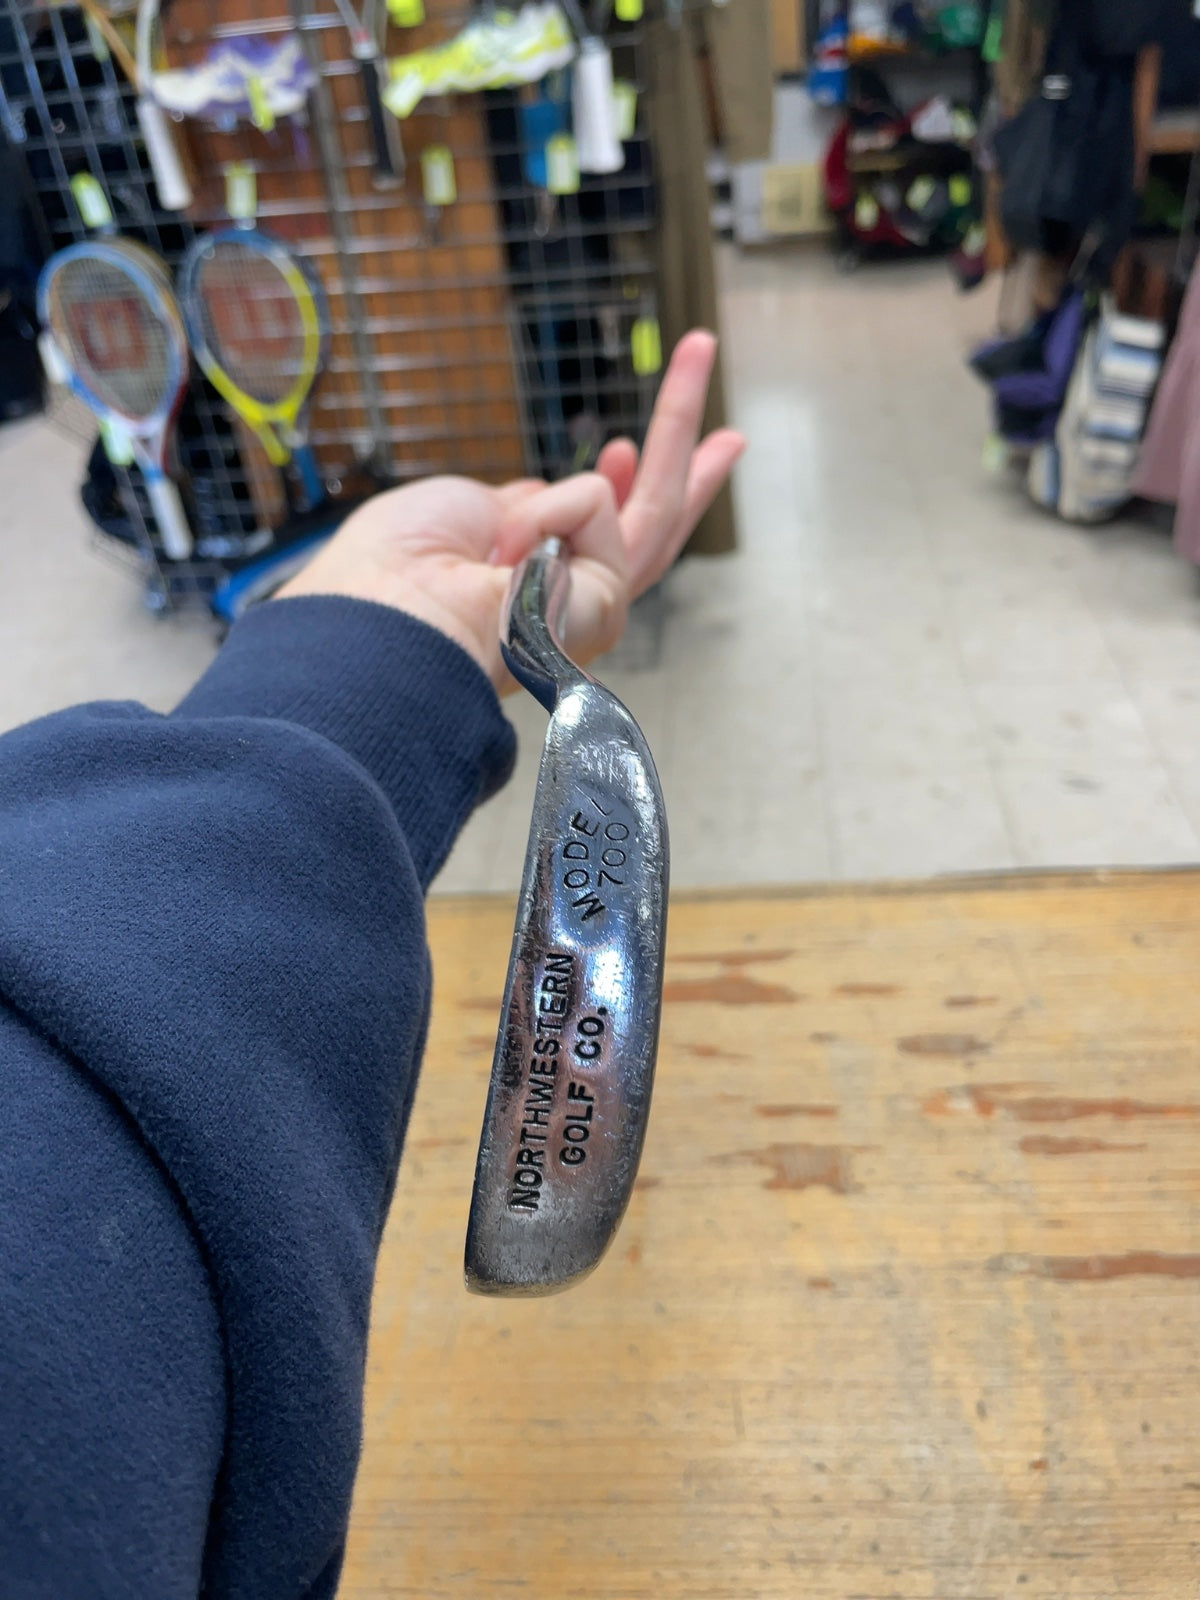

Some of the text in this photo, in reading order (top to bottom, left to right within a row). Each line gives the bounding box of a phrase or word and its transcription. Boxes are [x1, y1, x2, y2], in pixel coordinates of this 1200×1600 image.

[598, 822, 630, 887] 700
[508, 952, 574, 1213] NORTHWESTERN
[559, 1006, 607, 1167] GOLF CO.
